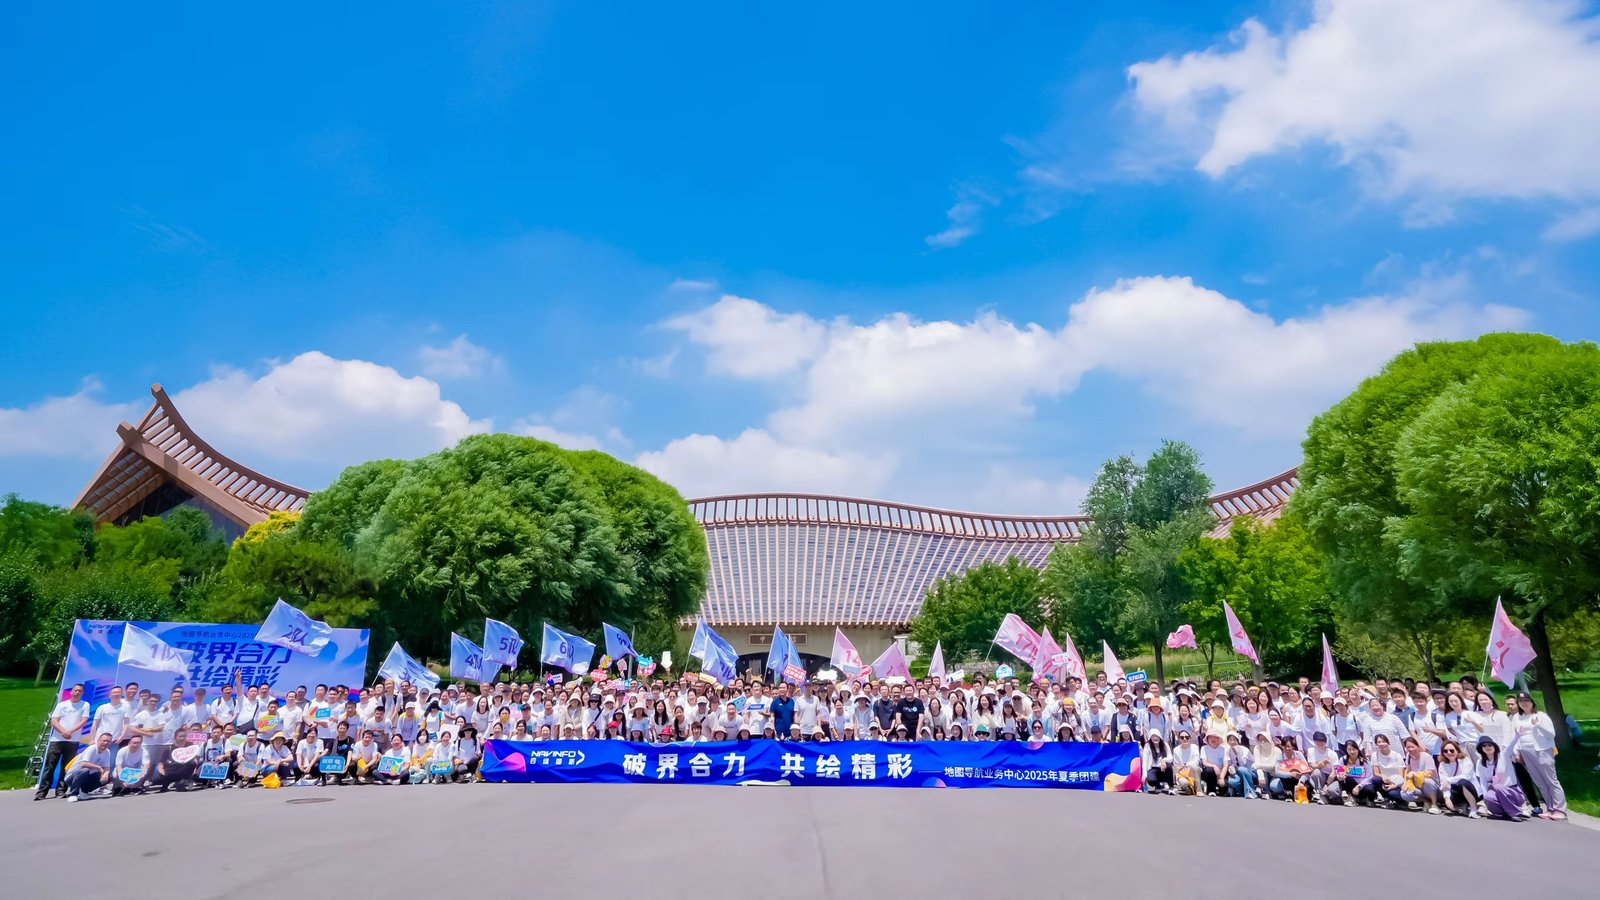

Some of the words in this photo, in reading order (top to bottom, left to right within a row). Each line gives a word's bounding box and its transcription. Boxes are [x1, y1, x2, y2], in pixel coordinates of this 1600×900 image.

[174, 641, 292, 666] 破界合力
[531, 750, 576, 758] NAVINFO
[622, 752, 746, 779] 破界合力
[780, 753, 913, 780] 共绘精彩
[944, 766, 1100, 783] 地图导航业务中心2025年夏季团建
